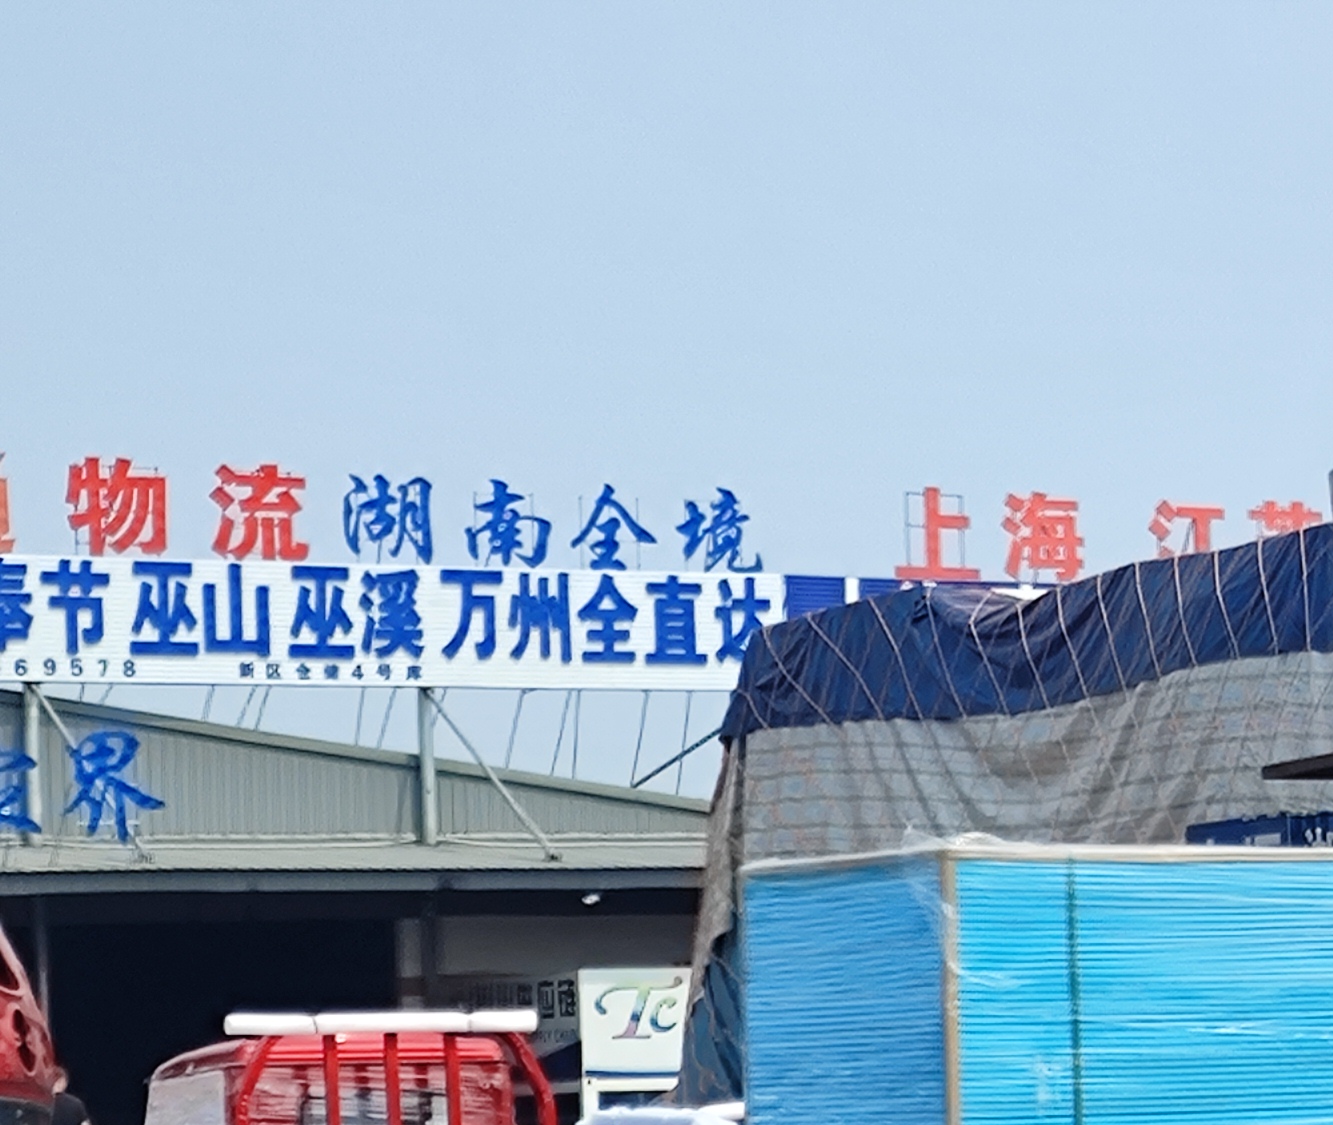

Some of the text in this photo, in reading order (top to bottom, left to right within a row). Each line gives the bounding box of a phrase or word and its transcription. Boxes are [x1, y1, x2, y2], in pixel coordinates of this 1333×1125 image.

[0, 453, 310, 561] 物流
[342, 473, 764, 573] 湖南全境
[894, 486, 1086, 583] 上海
